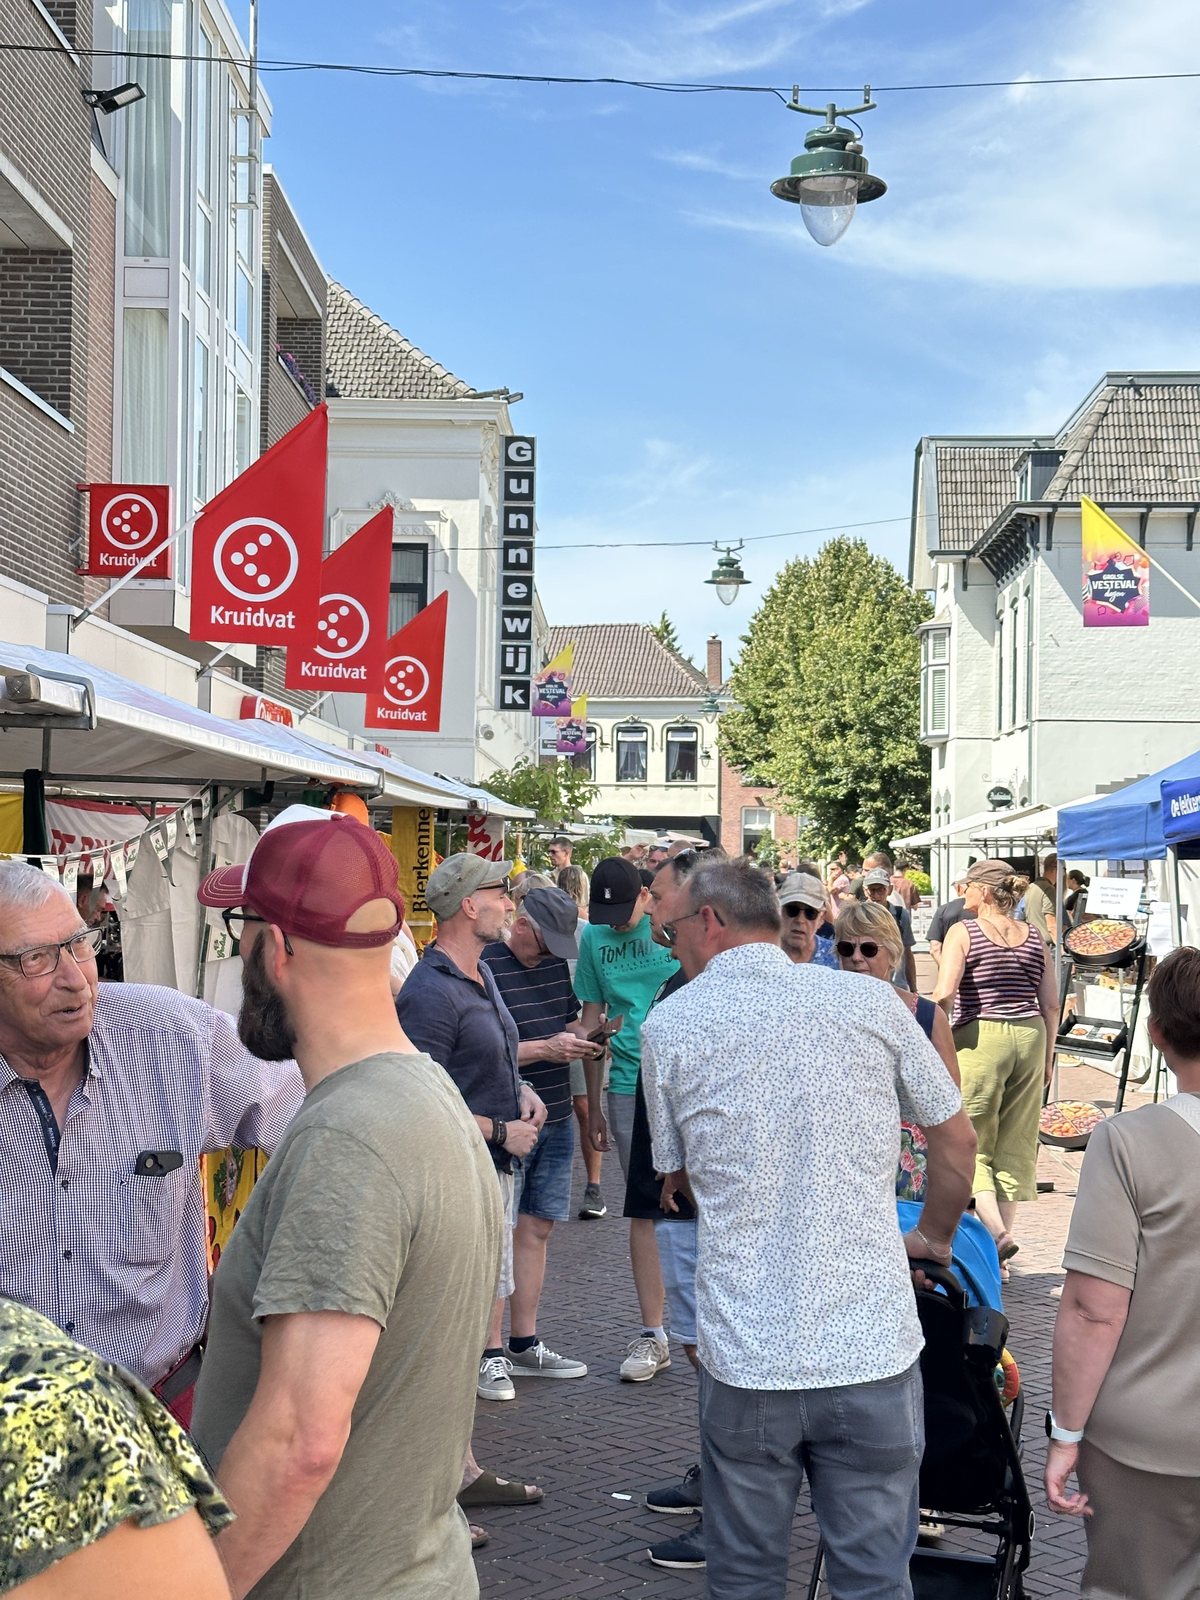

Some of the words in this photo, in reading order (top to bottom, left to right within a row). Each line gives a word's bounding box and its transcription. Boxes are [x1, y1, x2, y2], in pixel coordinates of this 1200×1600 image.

[99, 552, 158, 567] Kruidvt
[504, 440, 532, 704] Gunnewijk
[1091, 580, 1138, 589] VESTEVAL
[210, 605, 296, 629] Kruidvat
[300, 661, 367, 680] Kruidvat
[376, 707, 428, 722] Kruidvat
[1171, 799, 1181, 818] De
[412, 806, 431, 912] Bierkenne
[598, 942, 627, 965] TOM
